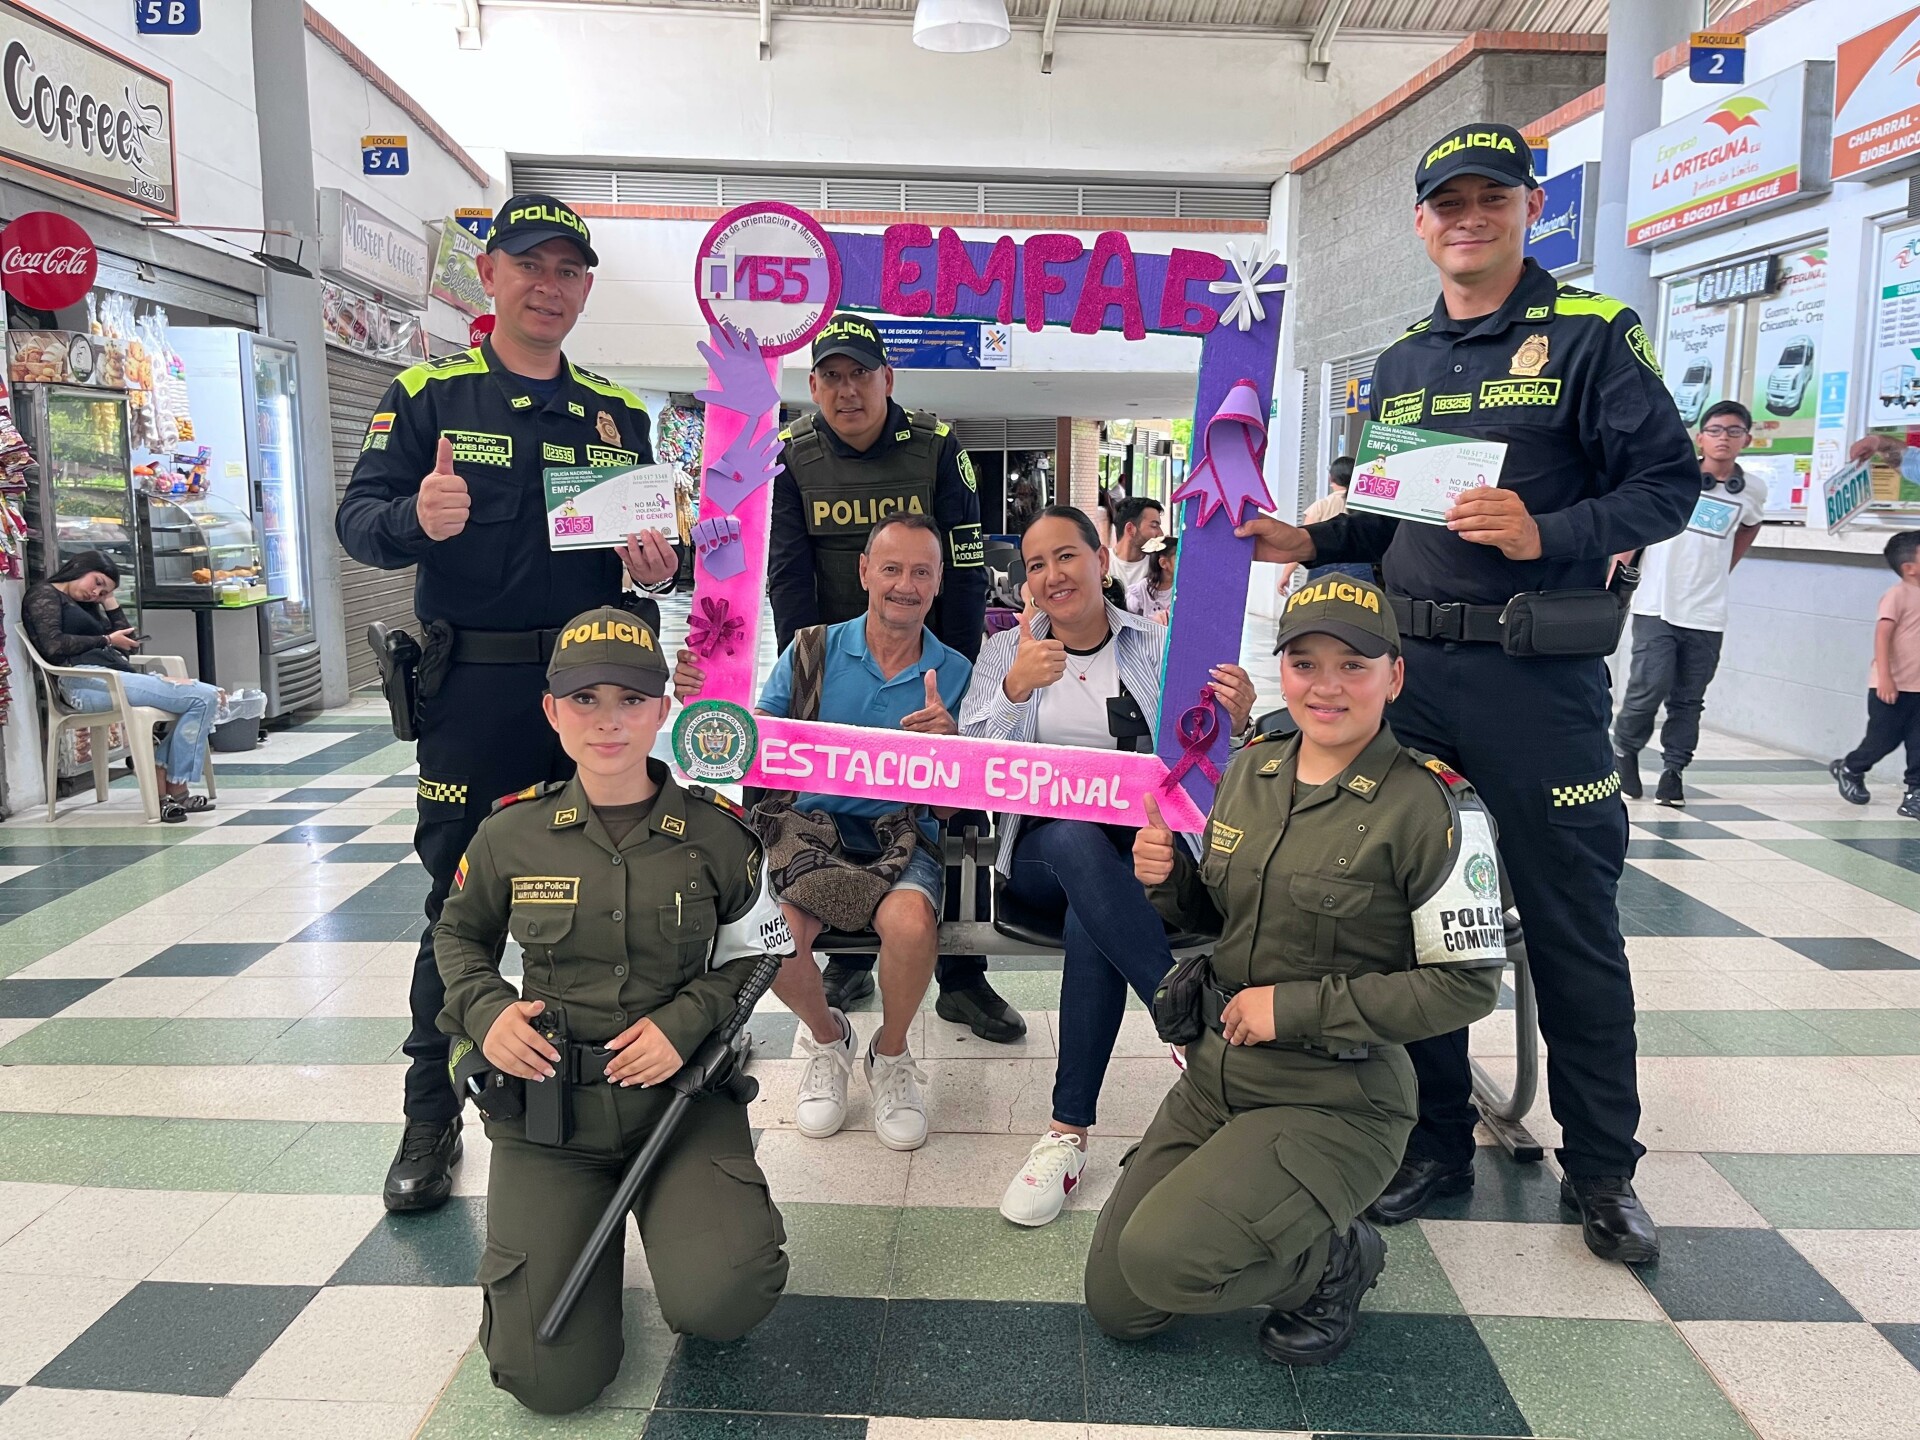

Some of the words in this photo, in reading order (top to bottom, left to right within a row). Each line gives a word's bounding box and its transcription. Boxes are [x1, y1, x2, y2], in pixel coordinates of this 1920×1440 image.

[146, 2, 162, 25] 5
[168, 3, 185, 25] B
[1697, 35, 1740, 45] TAQUILLA
[1708, 53, 1725, 75] 2
[4, 41, 133, 160] Coffee
[1848, 114, 1912, 149] CHAPARRAL
[369, 152, 381, 169] 5
[386, 152, 400, 169] A
[1652, 168, 1669, 190] LA
[1673, 136, 1748, 181] ORTEGUNA
[129, 177, 165, 201] J&D
[1637, 219, 1677, 242] ORTEGA
[1682, 195, 1728, 225] BOGOTÁ
[1737, 178, 1780, 208] IBAGUÉ
[344, 203, 384, 262] Master
[468, 221, 479, 234] 4
[729, 222, 740, 235] de
[741, 214, 790, 229] orientación
[791, 223, 798, 232] a
[798, 226, 824, 259] Mujeres
[1, 246, 92, 275] Coca-Cola
[734, 255, 811, 304] 155
[762, 336, 775, 346] de
[777, 310, 818, 345] Violencia
[1488, 381, 1549, 396] POLICÍA
[457, 434, 497, 445] Patrullero
[1392, 427, 1418, 436] NACIONAL
[478, 444, 506, 454] FLOREZ
[1367, 440, 1398, 452] EMFAG
[593, 450, 633, 465] POLICÍA
[551, 485, 581, 494] EMFAG
[1369, 477, 1397, 497] 155
[1450, 478, 1461, 486] NO
[565, 518, 592, 533] 155
[1287, 582, 1379, 614] POLICIA
[561, 620, 654, 652] POLICIA
[726, 715, 745, 746] COLOMBIA
[715, 753, 742, 770] NACIONAL
[761, 738, 960, 790] ESTACIÓN
[696, 767, 709, 777] DIOS
[715, 769, 736, 777] PATRIA
[535, 882, 544, 890] de
[540, 891, 564, 899] OLIVAR
